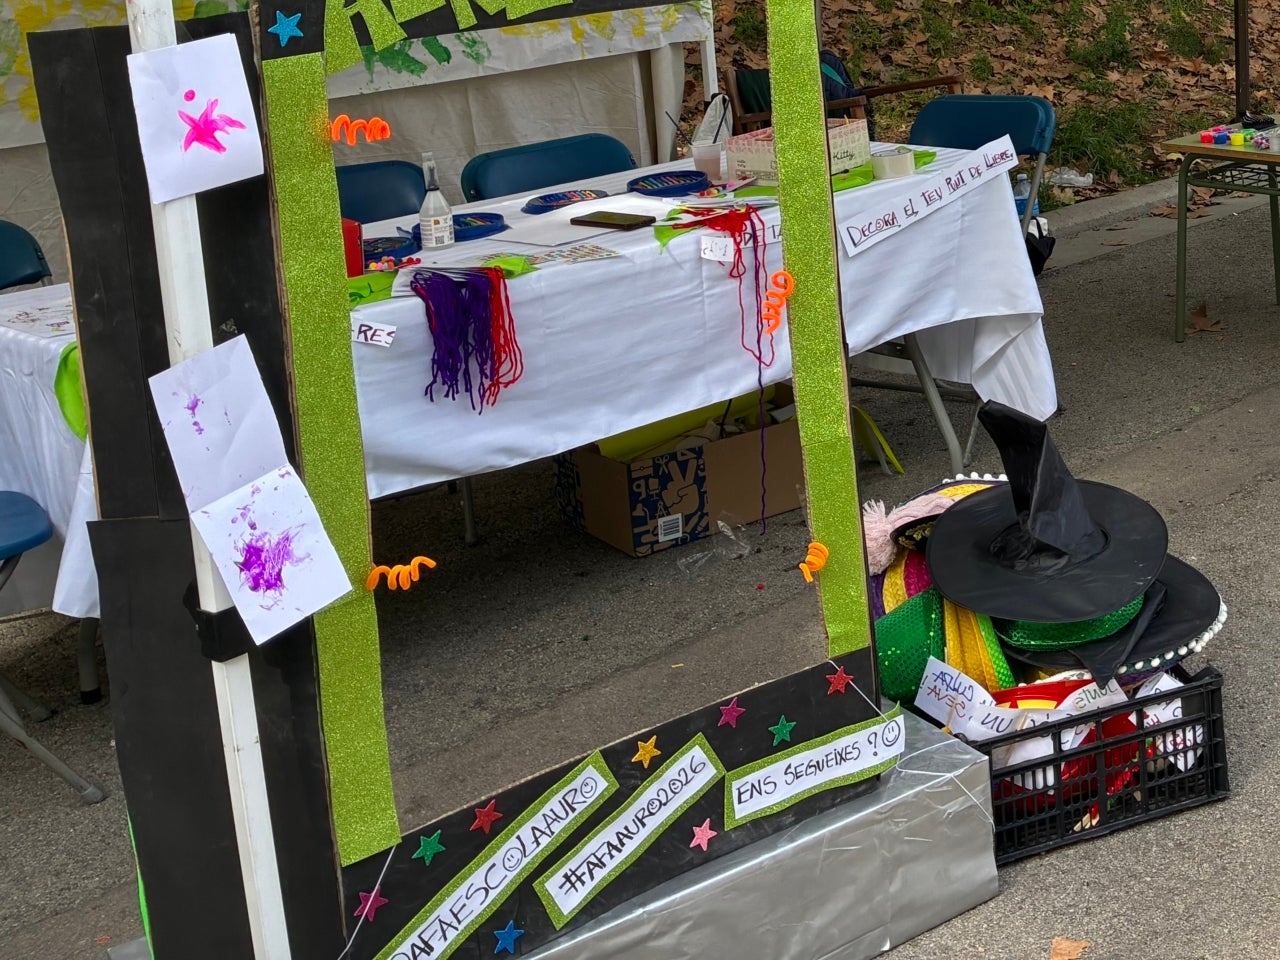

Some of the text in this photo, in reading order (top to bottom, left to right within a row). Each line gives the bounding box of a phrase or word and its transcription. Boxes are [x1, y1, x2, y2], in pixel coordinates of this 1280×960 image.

[847, 211, 898, 248] DECORA
[904, 198, 918, 217] EL
[969, 165, 982, 179] DE
[737, 775, 777, 805] ENS
